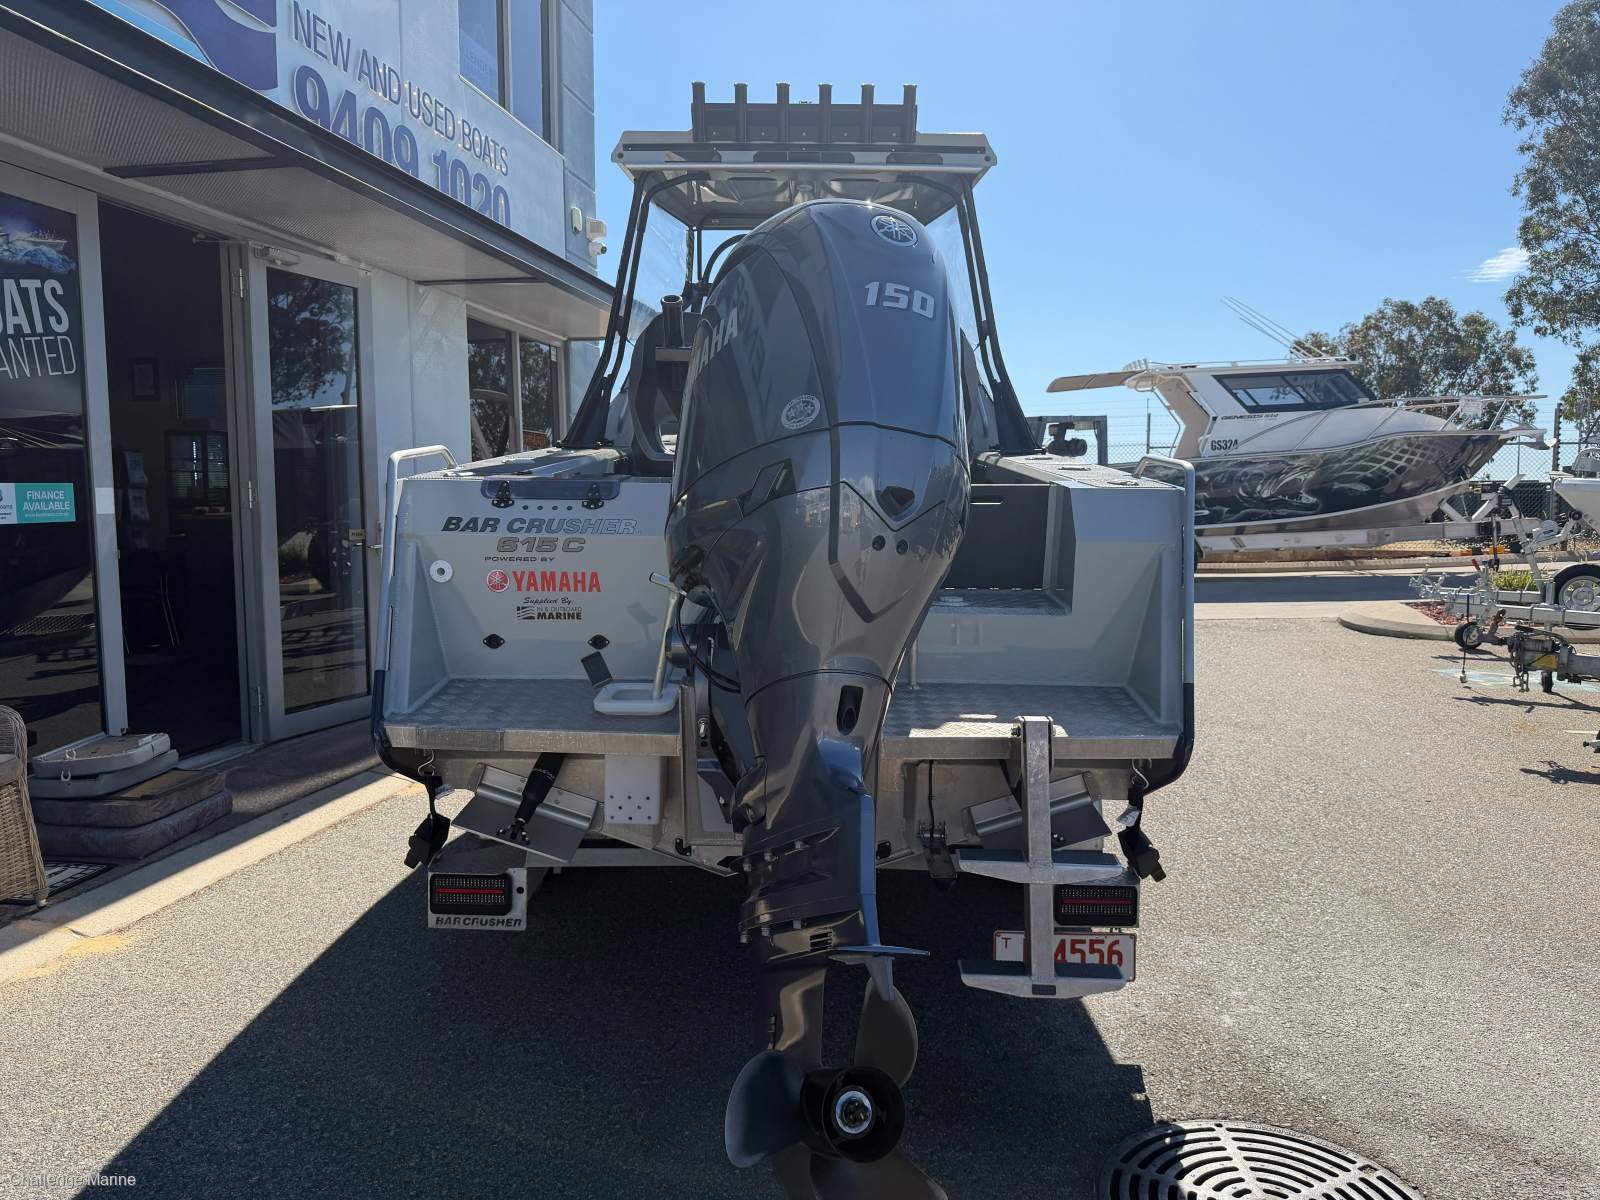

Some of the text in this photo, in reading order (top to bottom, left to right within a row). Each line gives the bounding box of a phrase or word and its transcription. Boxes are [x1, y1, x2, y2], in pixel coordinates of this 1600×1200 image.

[293, 0, 351, 72] NEW
[357, 48, 401, 105] AND
[408, 81, 455, 141] USED
[461, 118, 509, 177] BOATS
[0, 278, 70, 333] ATS
[864, 280, 936, 320] 150
[26, 490, 65, 501] FINANCE
[22, 501, 71, 511] AVAILABLE
[441, 516, 638, 535] BAR CRUSHER
[511, 570, 602, 593] YAMAHA
[523, 597, 559, 605] Supplied
[536, 612, 583, 620] MARINE
[1001, 937, 1012, 949] T
